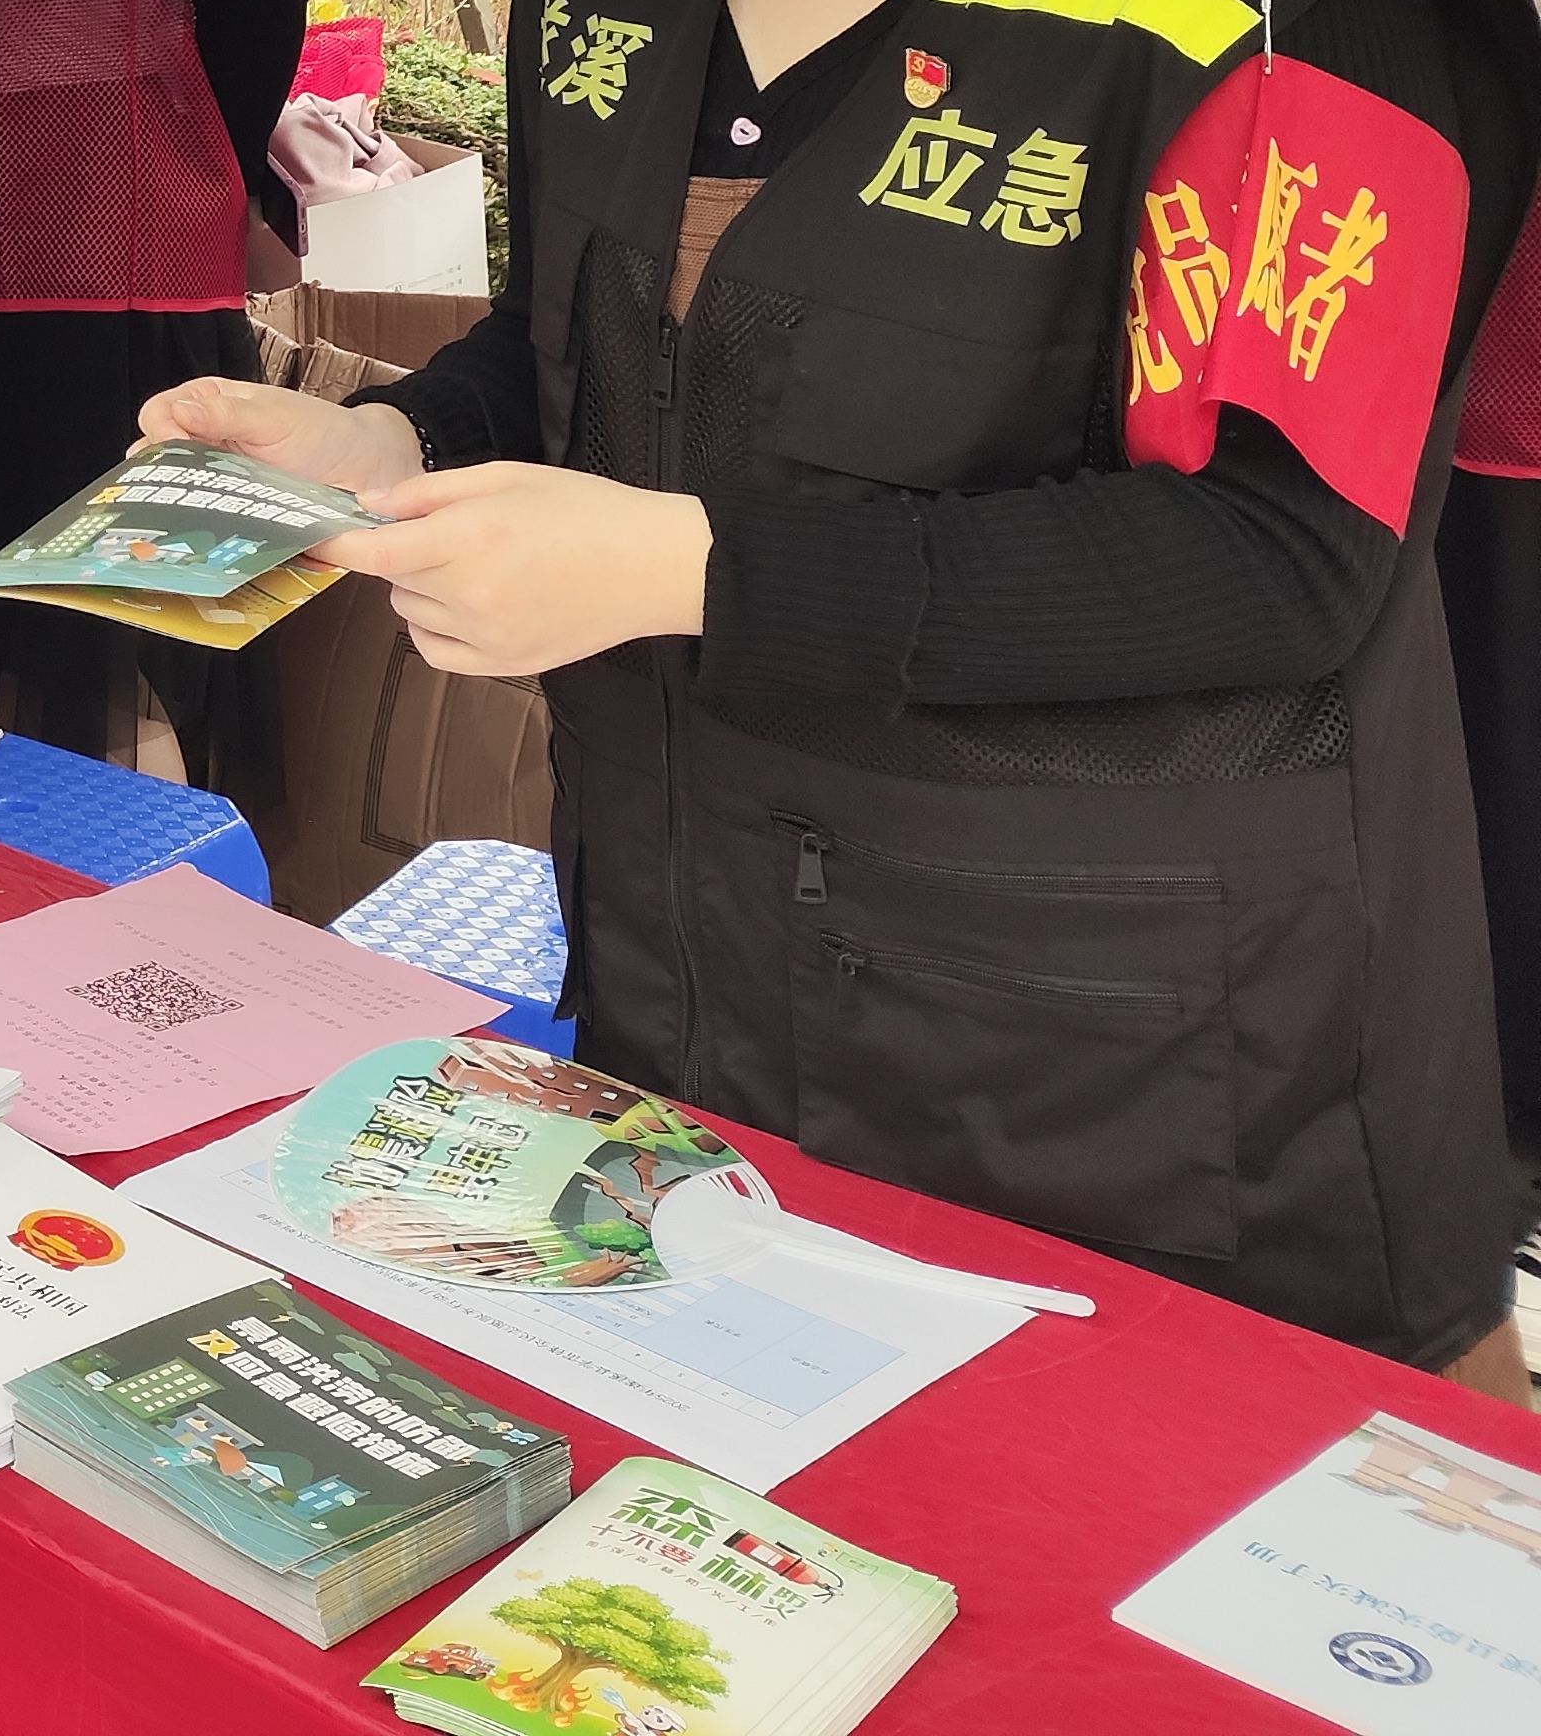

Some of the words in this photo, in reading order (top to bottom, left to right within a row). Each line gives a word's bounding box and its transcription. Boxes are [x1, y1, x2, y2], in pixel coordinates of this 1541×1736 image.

[857, 107, 1091, 249] 应急
[86, 484, 322, 529] 及应急避险措施
[115, 464, 349, 522] 暴雨洪涝的防御
[186, 1327, 443, 1481] 及应急避险措施
[225, 1315, 481, 1463] 暴雨洪涝的防御
[591, 1523, 697, 1567] 十不要
[608, 1486, 732, 1549] 森
[697, 1553, 774, 1601] 林
